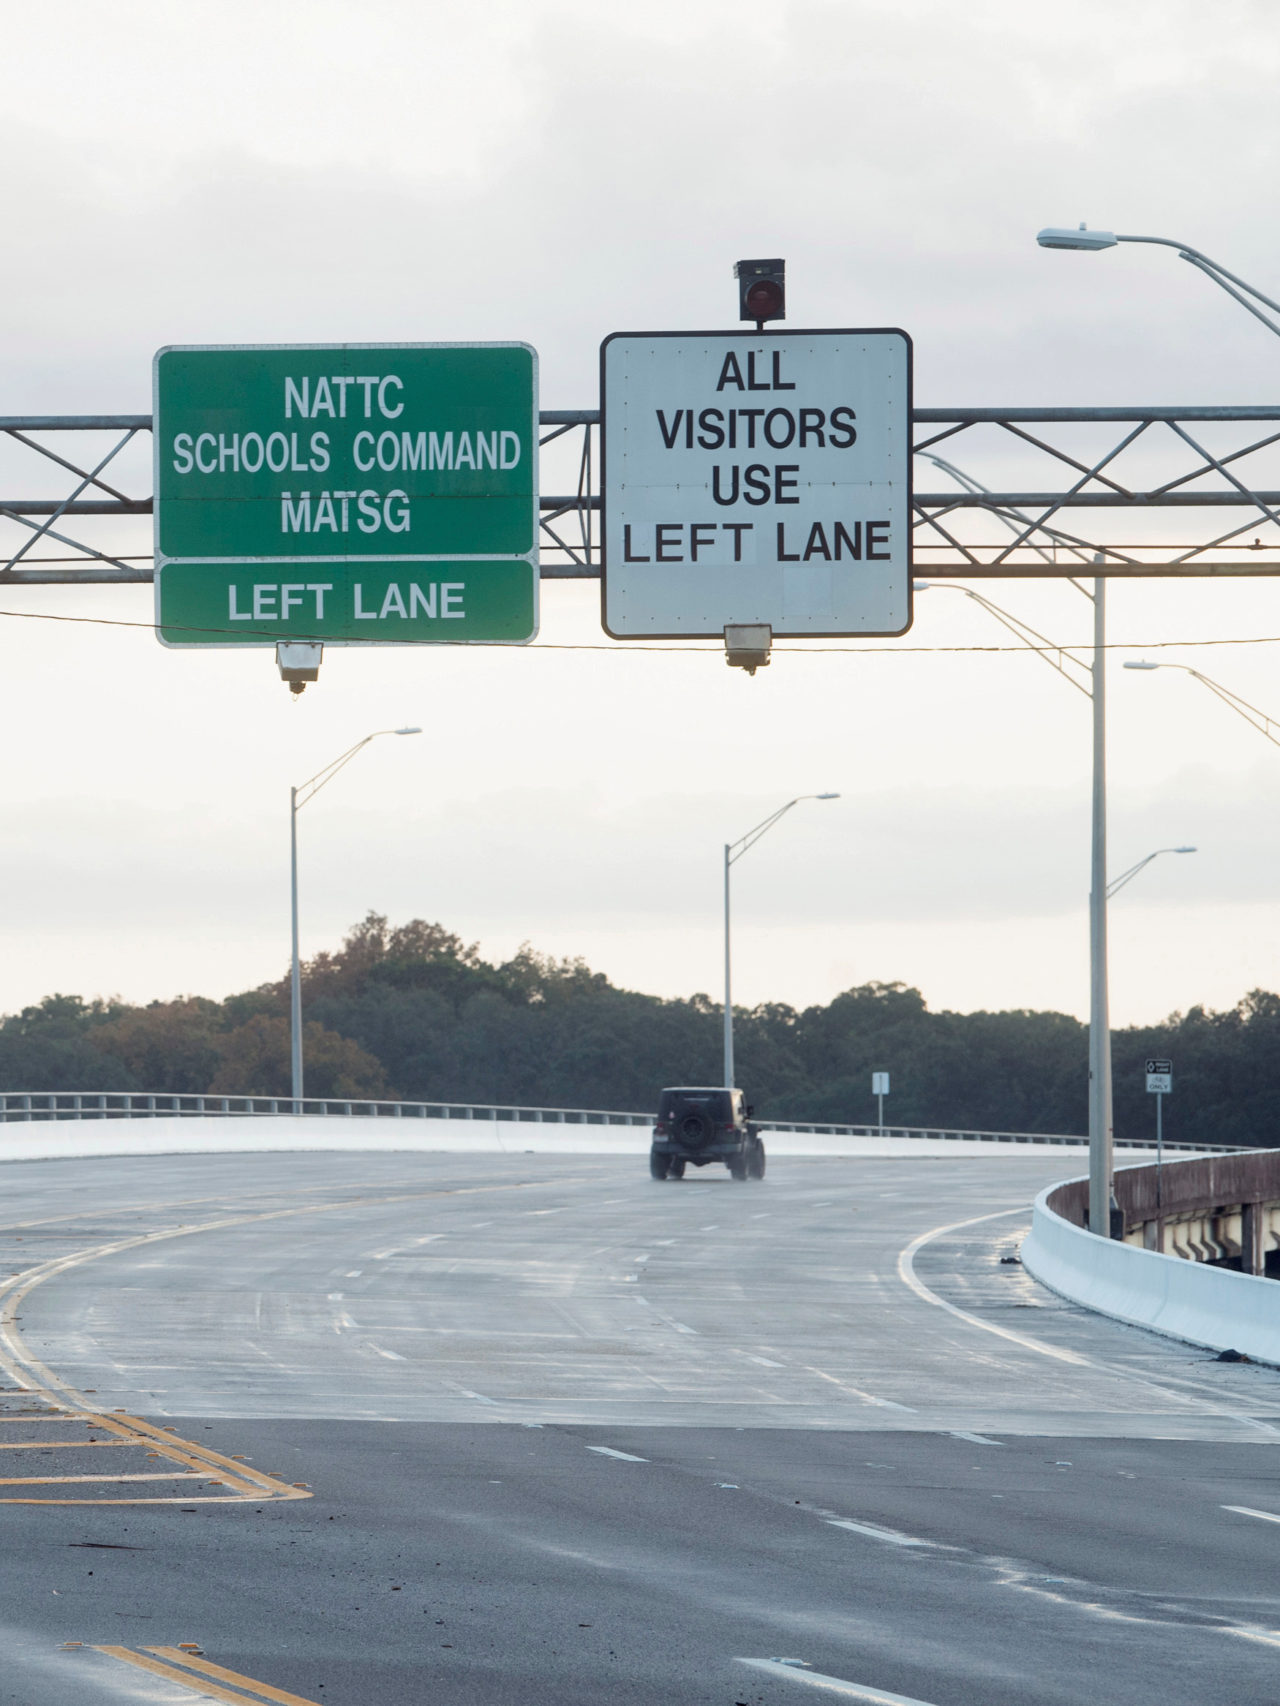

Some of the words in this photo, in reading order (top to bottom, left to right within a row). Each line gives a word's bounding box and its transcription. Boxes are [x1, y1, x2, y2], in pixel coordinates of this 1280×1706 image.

[716, 351, 795, 392] ALL
[285, 375, 404, 419] NATTC
[656, 407, 857, 450] VISITORS
[173, 432, 331, 474] SCHOOLS
[353, 431, 521, 472] COMMAND
[712, 464, 800, 506] USE
[281, 489, 411, 534] MATSG
[624, 522, 753, 563] LEFT
[777, 521, 891, 562] LANE
[229, 584, 332, 621] LEFT
[354, 583, 465, 620] LANE
